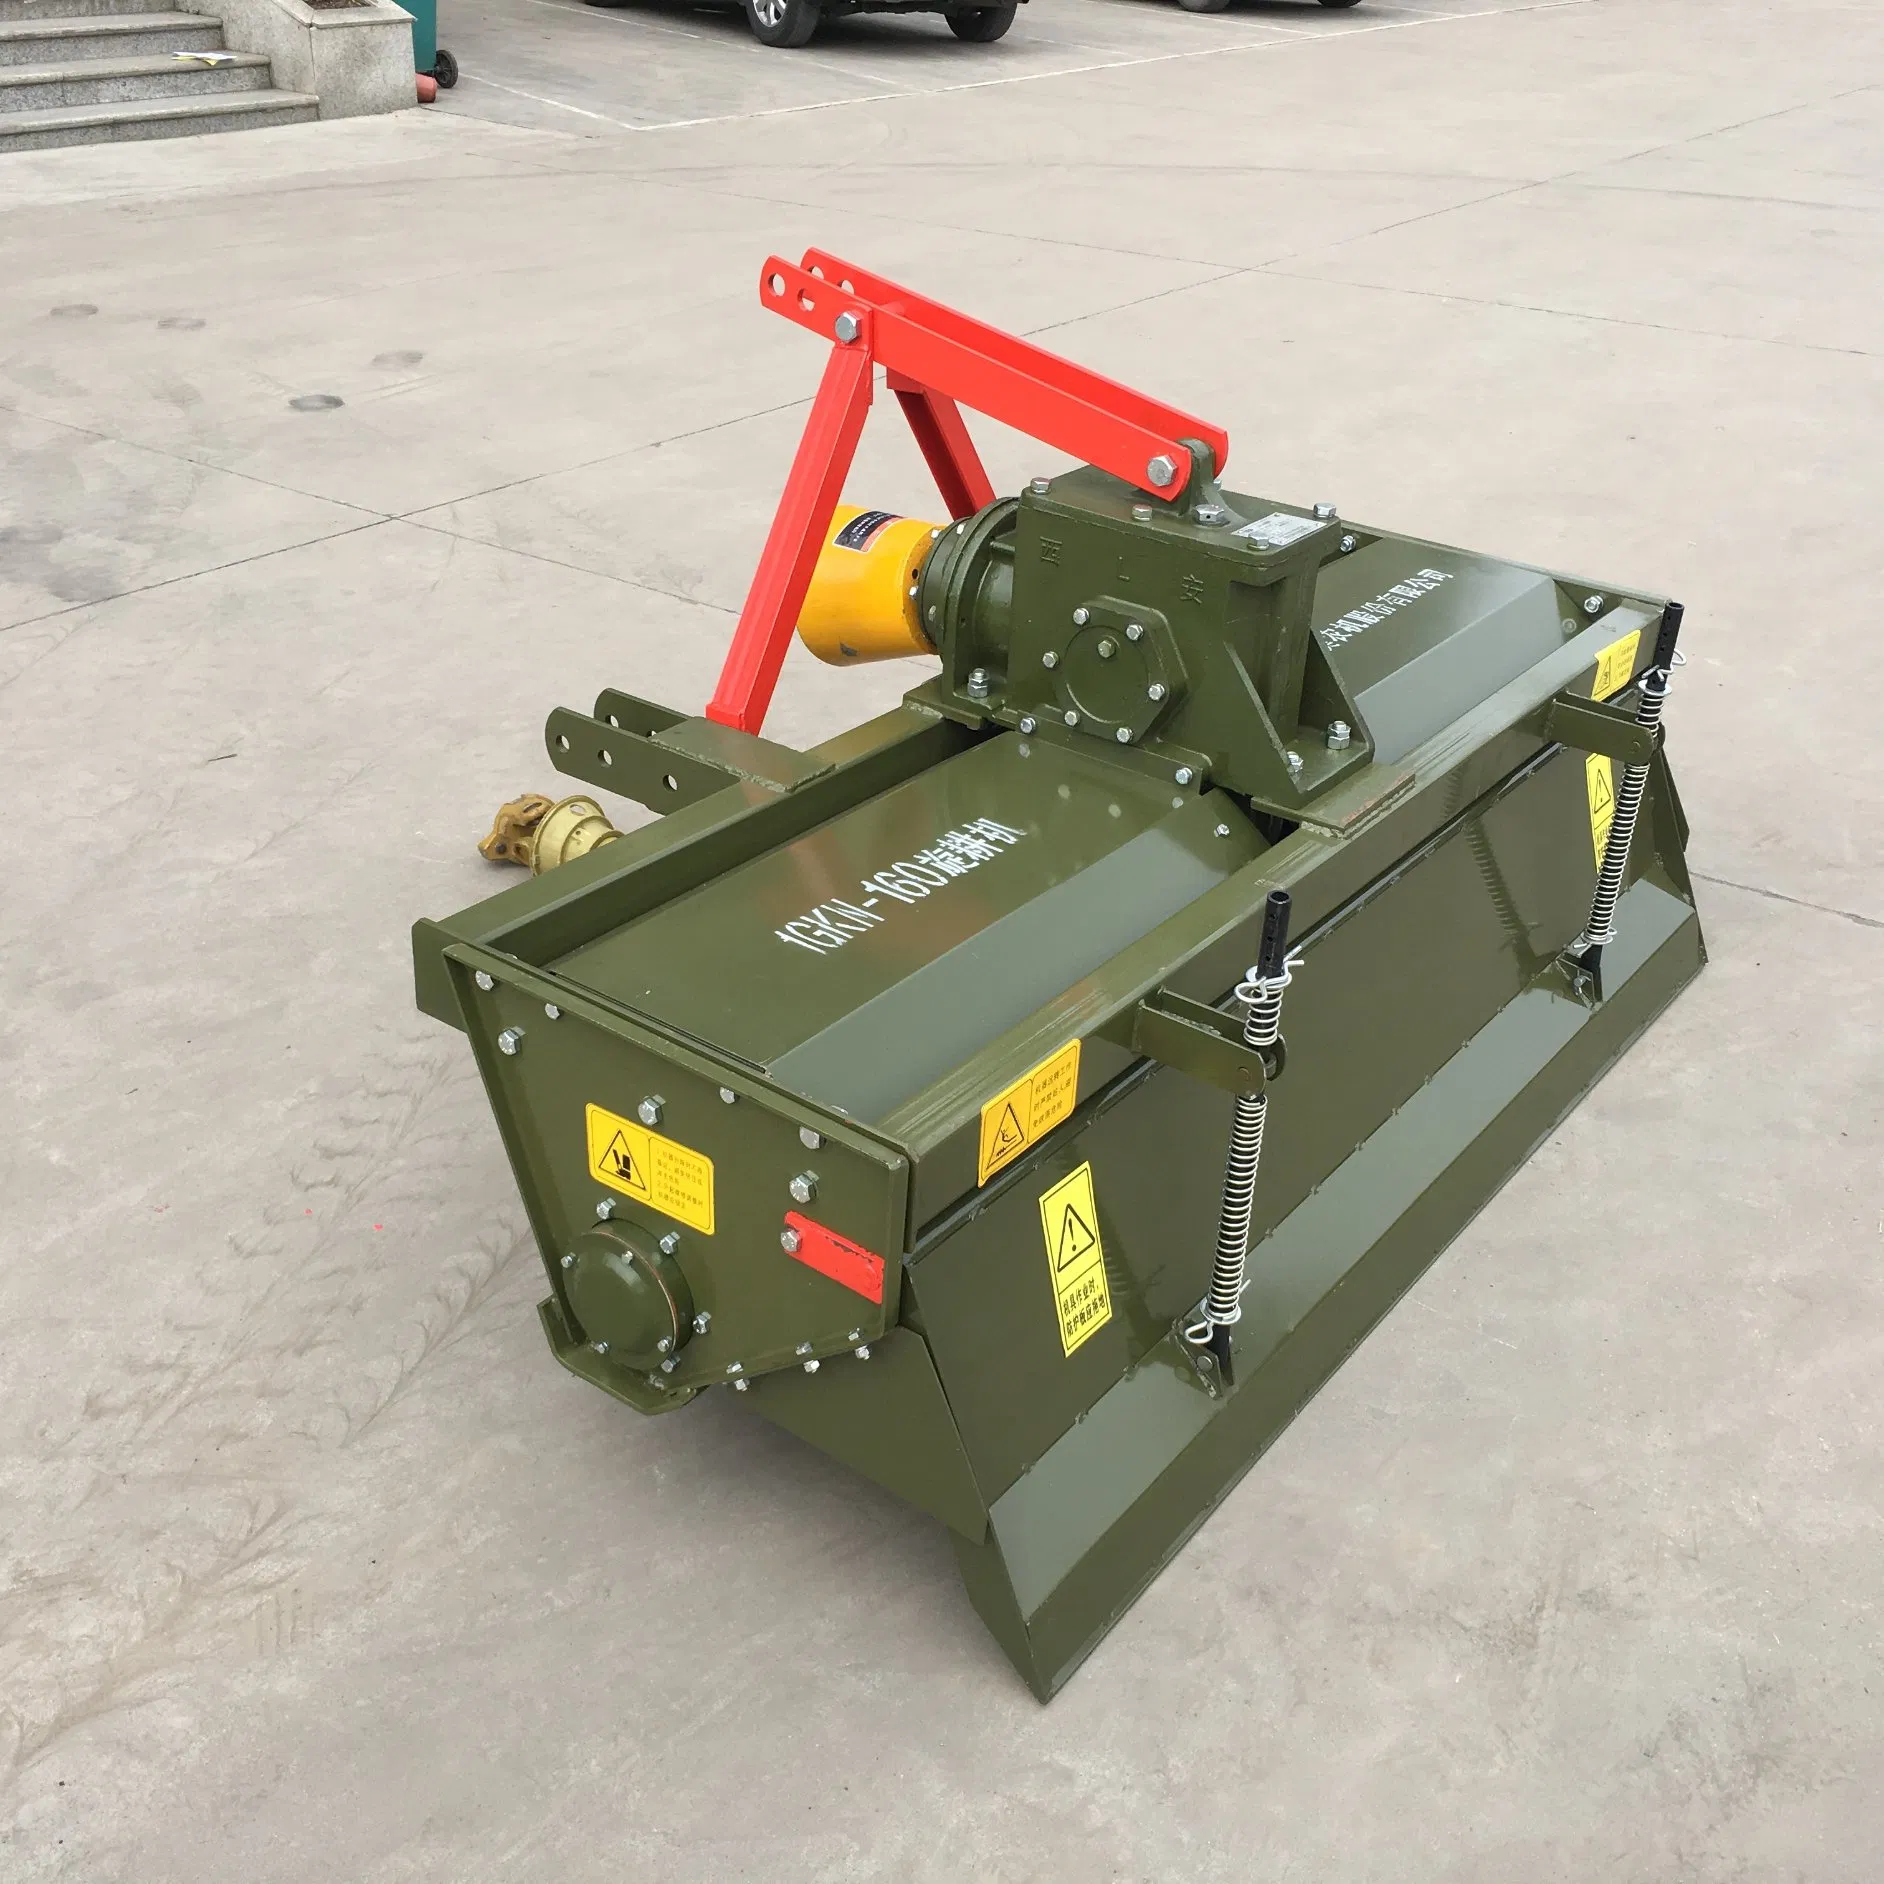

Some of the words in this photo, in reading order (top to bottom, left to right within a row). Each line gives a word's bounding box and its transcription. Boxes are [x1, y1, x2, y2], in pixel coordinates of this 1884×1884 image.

[1320, 568, 1454, 651] 农机股份有限公司
[774, 817, 1027, 955] 1GKN-160旋耕机
